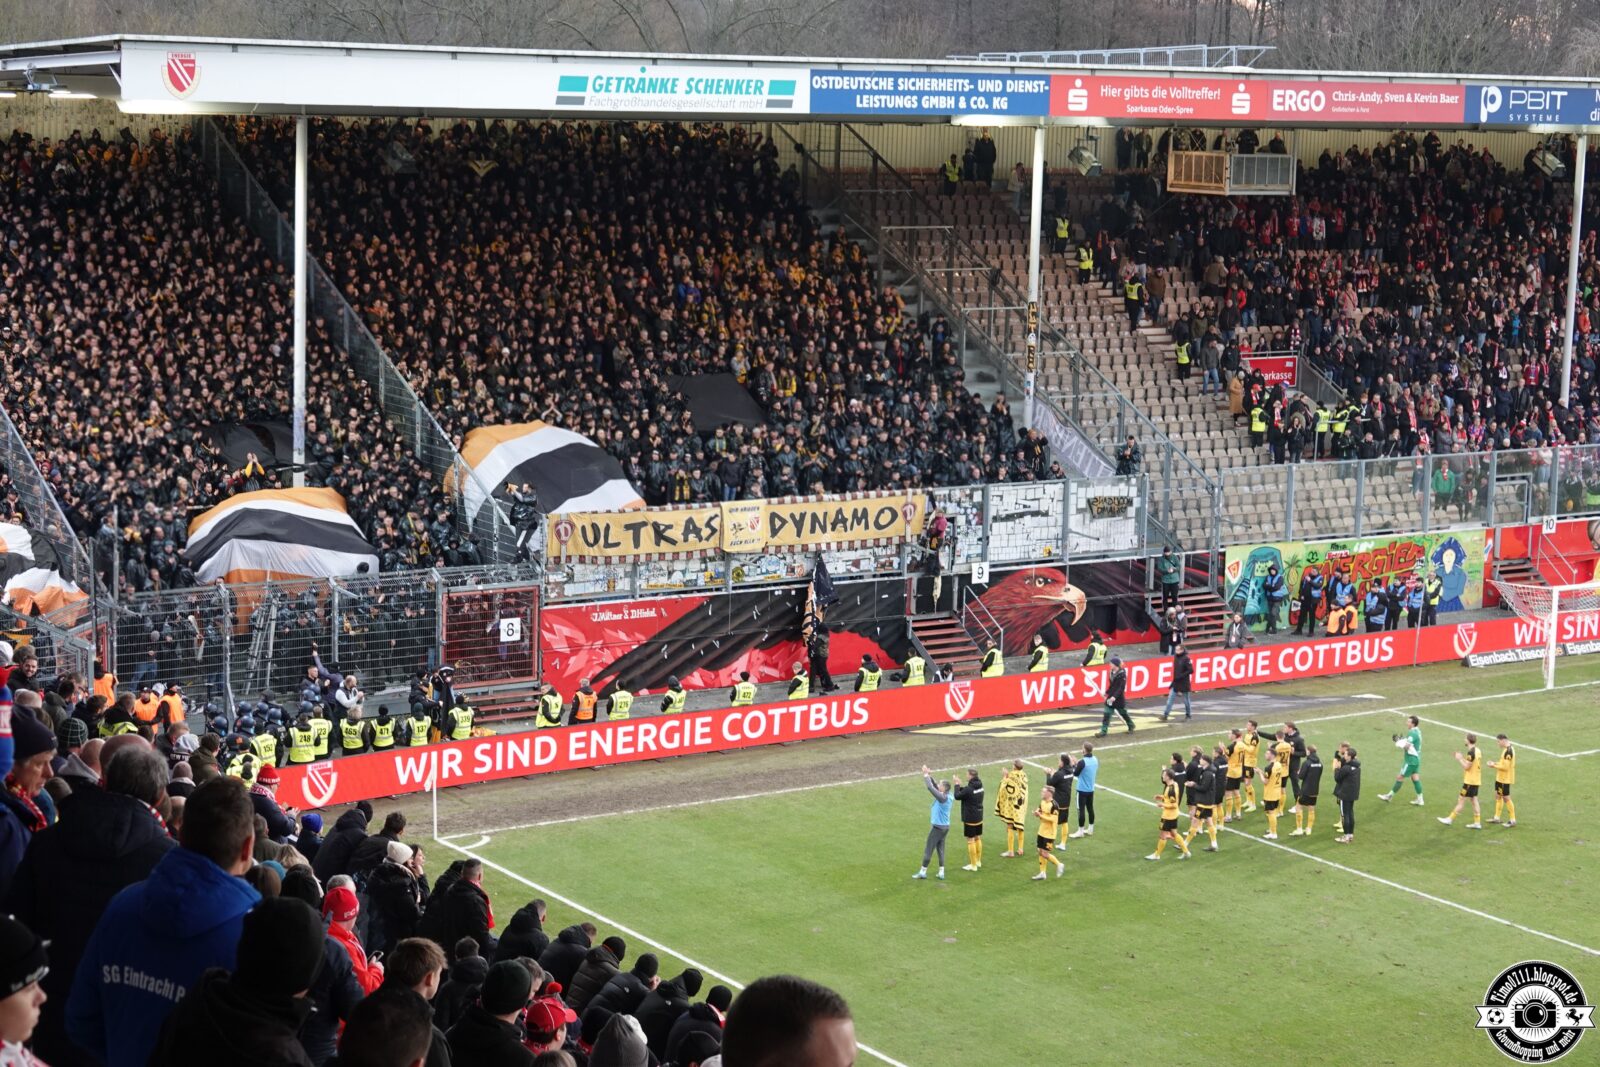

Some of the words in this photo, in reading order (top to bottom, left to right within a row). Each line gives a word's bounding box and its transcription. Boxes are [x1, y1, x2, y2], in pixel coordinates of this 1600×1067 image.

[684, 77, 764, 95] SCHENKER
[812, 75, 894, 91] OSTDEUTSCHE
[897, 78, 975, 92] SICHERHEITS-
[977, 80, 1002, 93] UND
[1006, 80, 1049, 93] DIENST-
[1100, 85, 1122, 98] Hier
[1124, 85, 1150, 101] gibts
[1152, 86, 1167, 99] die
[1169, 87, 1221, 100] Volltreffer!
[1272, 89, 1326, 112] ERGO
[1332, 90, 1383, 105] Chris-Andy,
[1384, 92, 1405, 103] Sven
[1405, 92, 1412, 103] &
[1414, 92, 1437, 104] Kevin
[1440, 93, 1459, 104] Baer
[1509, 89, 1568, 110] PBIT
[588, 94, 736, 109] Fachgroßhandelsgesellschaft
[739, 98, 763, 109] mbH
[856, 94, 918, 108] LEISTUNGS
[921, 95, 954, 109] GMBH
[958, 96, 967, 109] &
[970, 97, 989, 109] CO.
[992, 97, 1008, 110] KG
[1126, 104, 1158, 113] Sparkasse
[1159, 105, 1194, 115] Oder-Spree
[1509, 113, 1560, 122] SYSTEME
[1261, 370, 1293, 381] arkasse
[580, 513, 720, 550] ULTRAS
[769, 506, 899, 539] DYNAMO
[1544, 518, 1555, 530] 10
[976, 566, 984, 579] 9
[1469, 650, 1517, 667] Eisenbach
[1020, 674, 1076, 705] WIR
[1083, 664, 1150, 699] SID
[1157, 651, 1271, 690] EERGIE
[1278, 636, 1394, 673] COTTBUS
[344, 727, 357, 735] 465
[394, 748, 463, 785] WIR
[473, 736, 558, 774] SIND
[568, 716, 713, 762] ENERGIE
[722, 697, 870, 742] COTTBUS
[102, 964, 121, 984] SG
[123, 965, 176, 1000] Eintracht
[175, 985, 186, 1003] P
